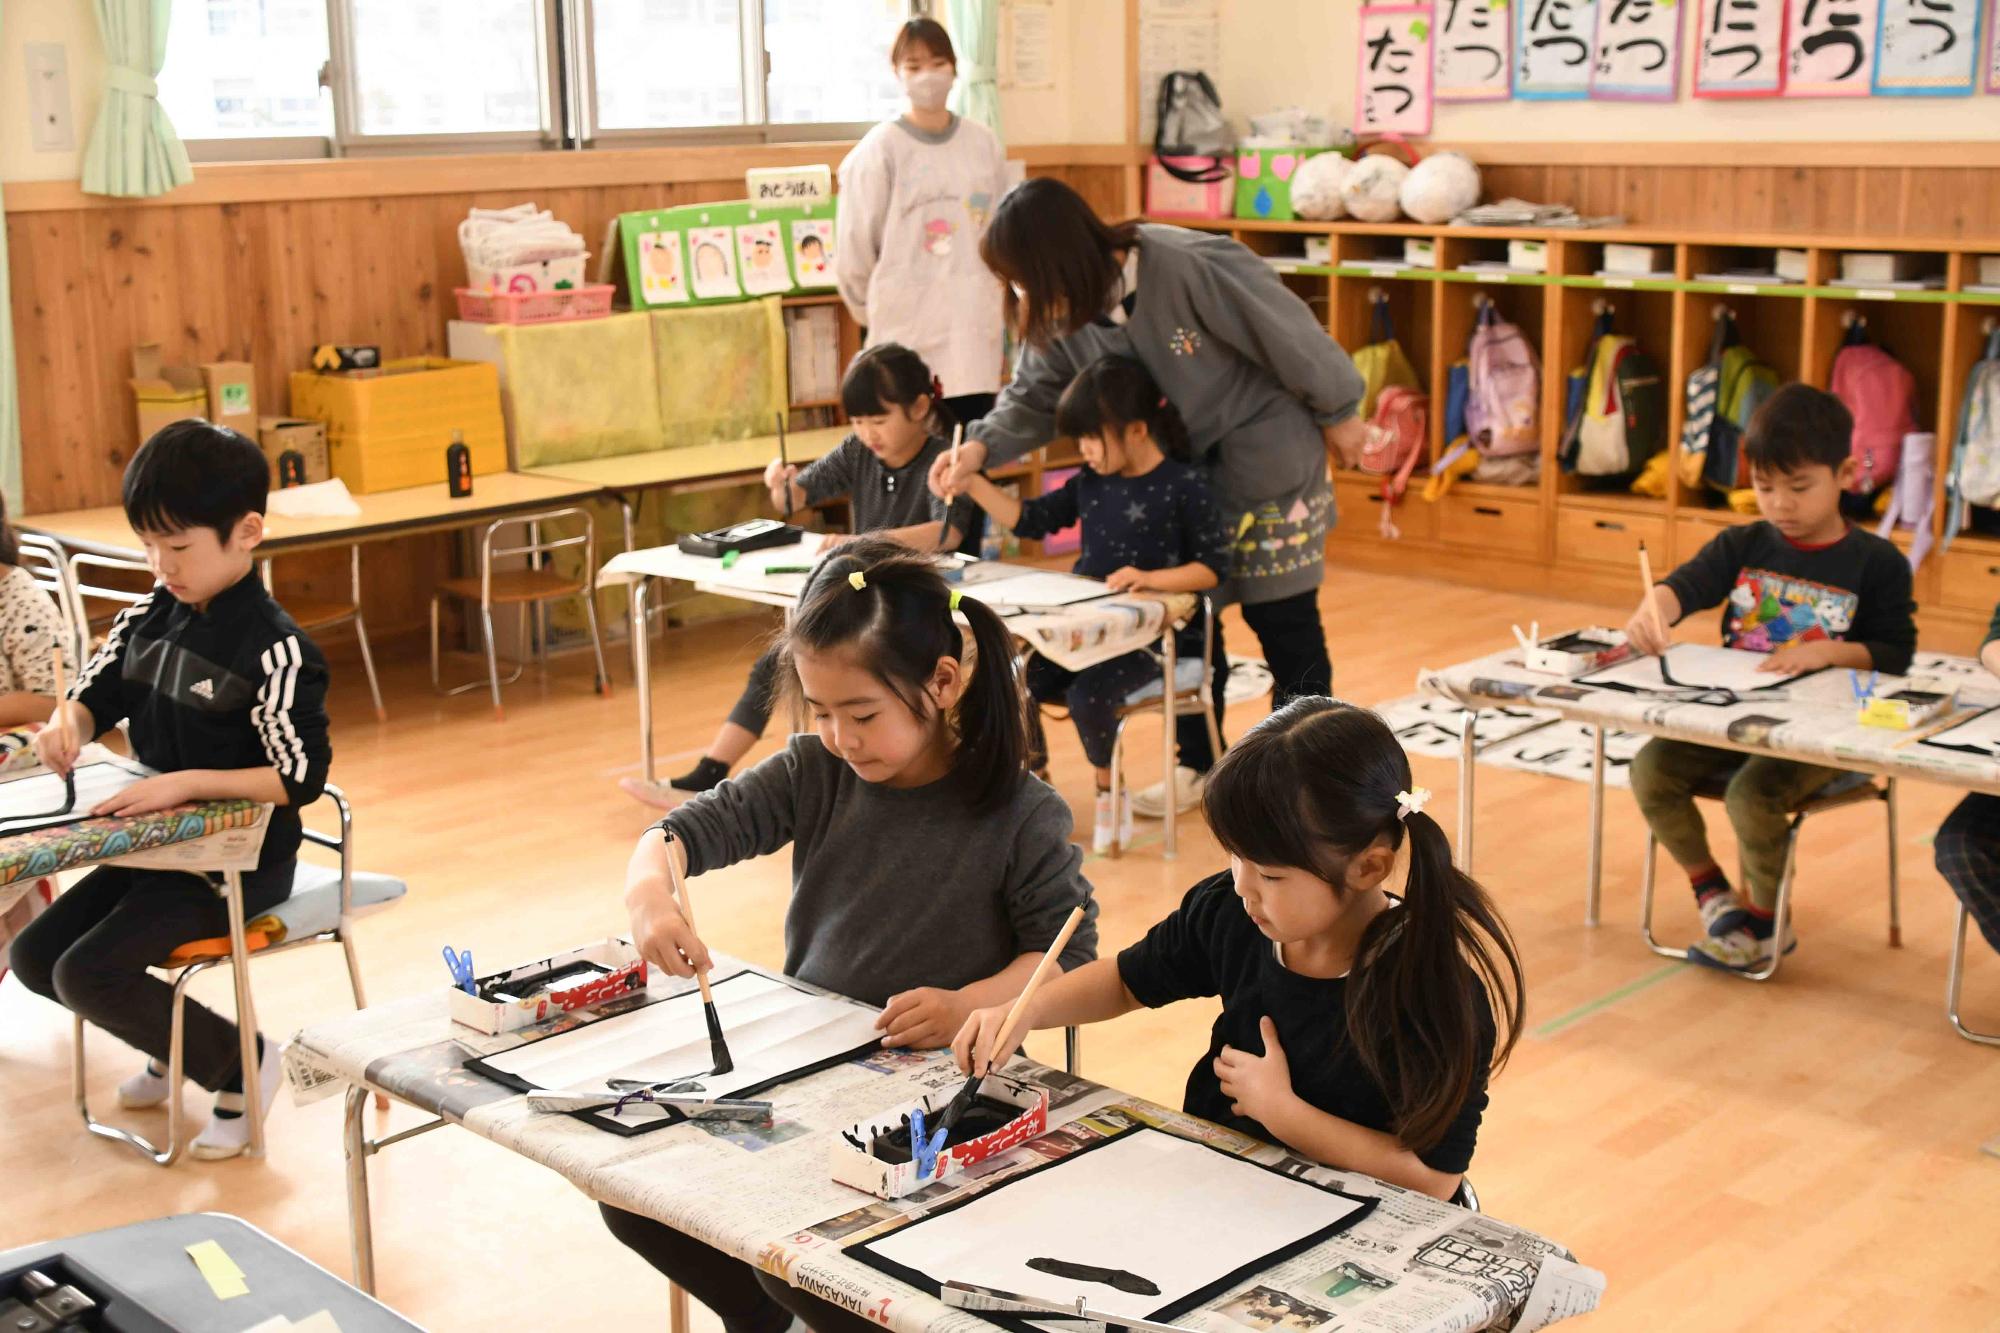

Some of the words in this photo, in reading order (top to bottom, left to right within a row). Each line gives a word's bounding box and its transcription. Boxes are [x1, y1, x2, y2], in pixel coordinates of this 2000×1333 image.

[1907, 0, 1957, 60] つ
[1367, 27, 1414, 115] たつ
[986, 1118, 1040, 1157] おいしい
[796, 1271, 865, 1315] TAKASAWA
